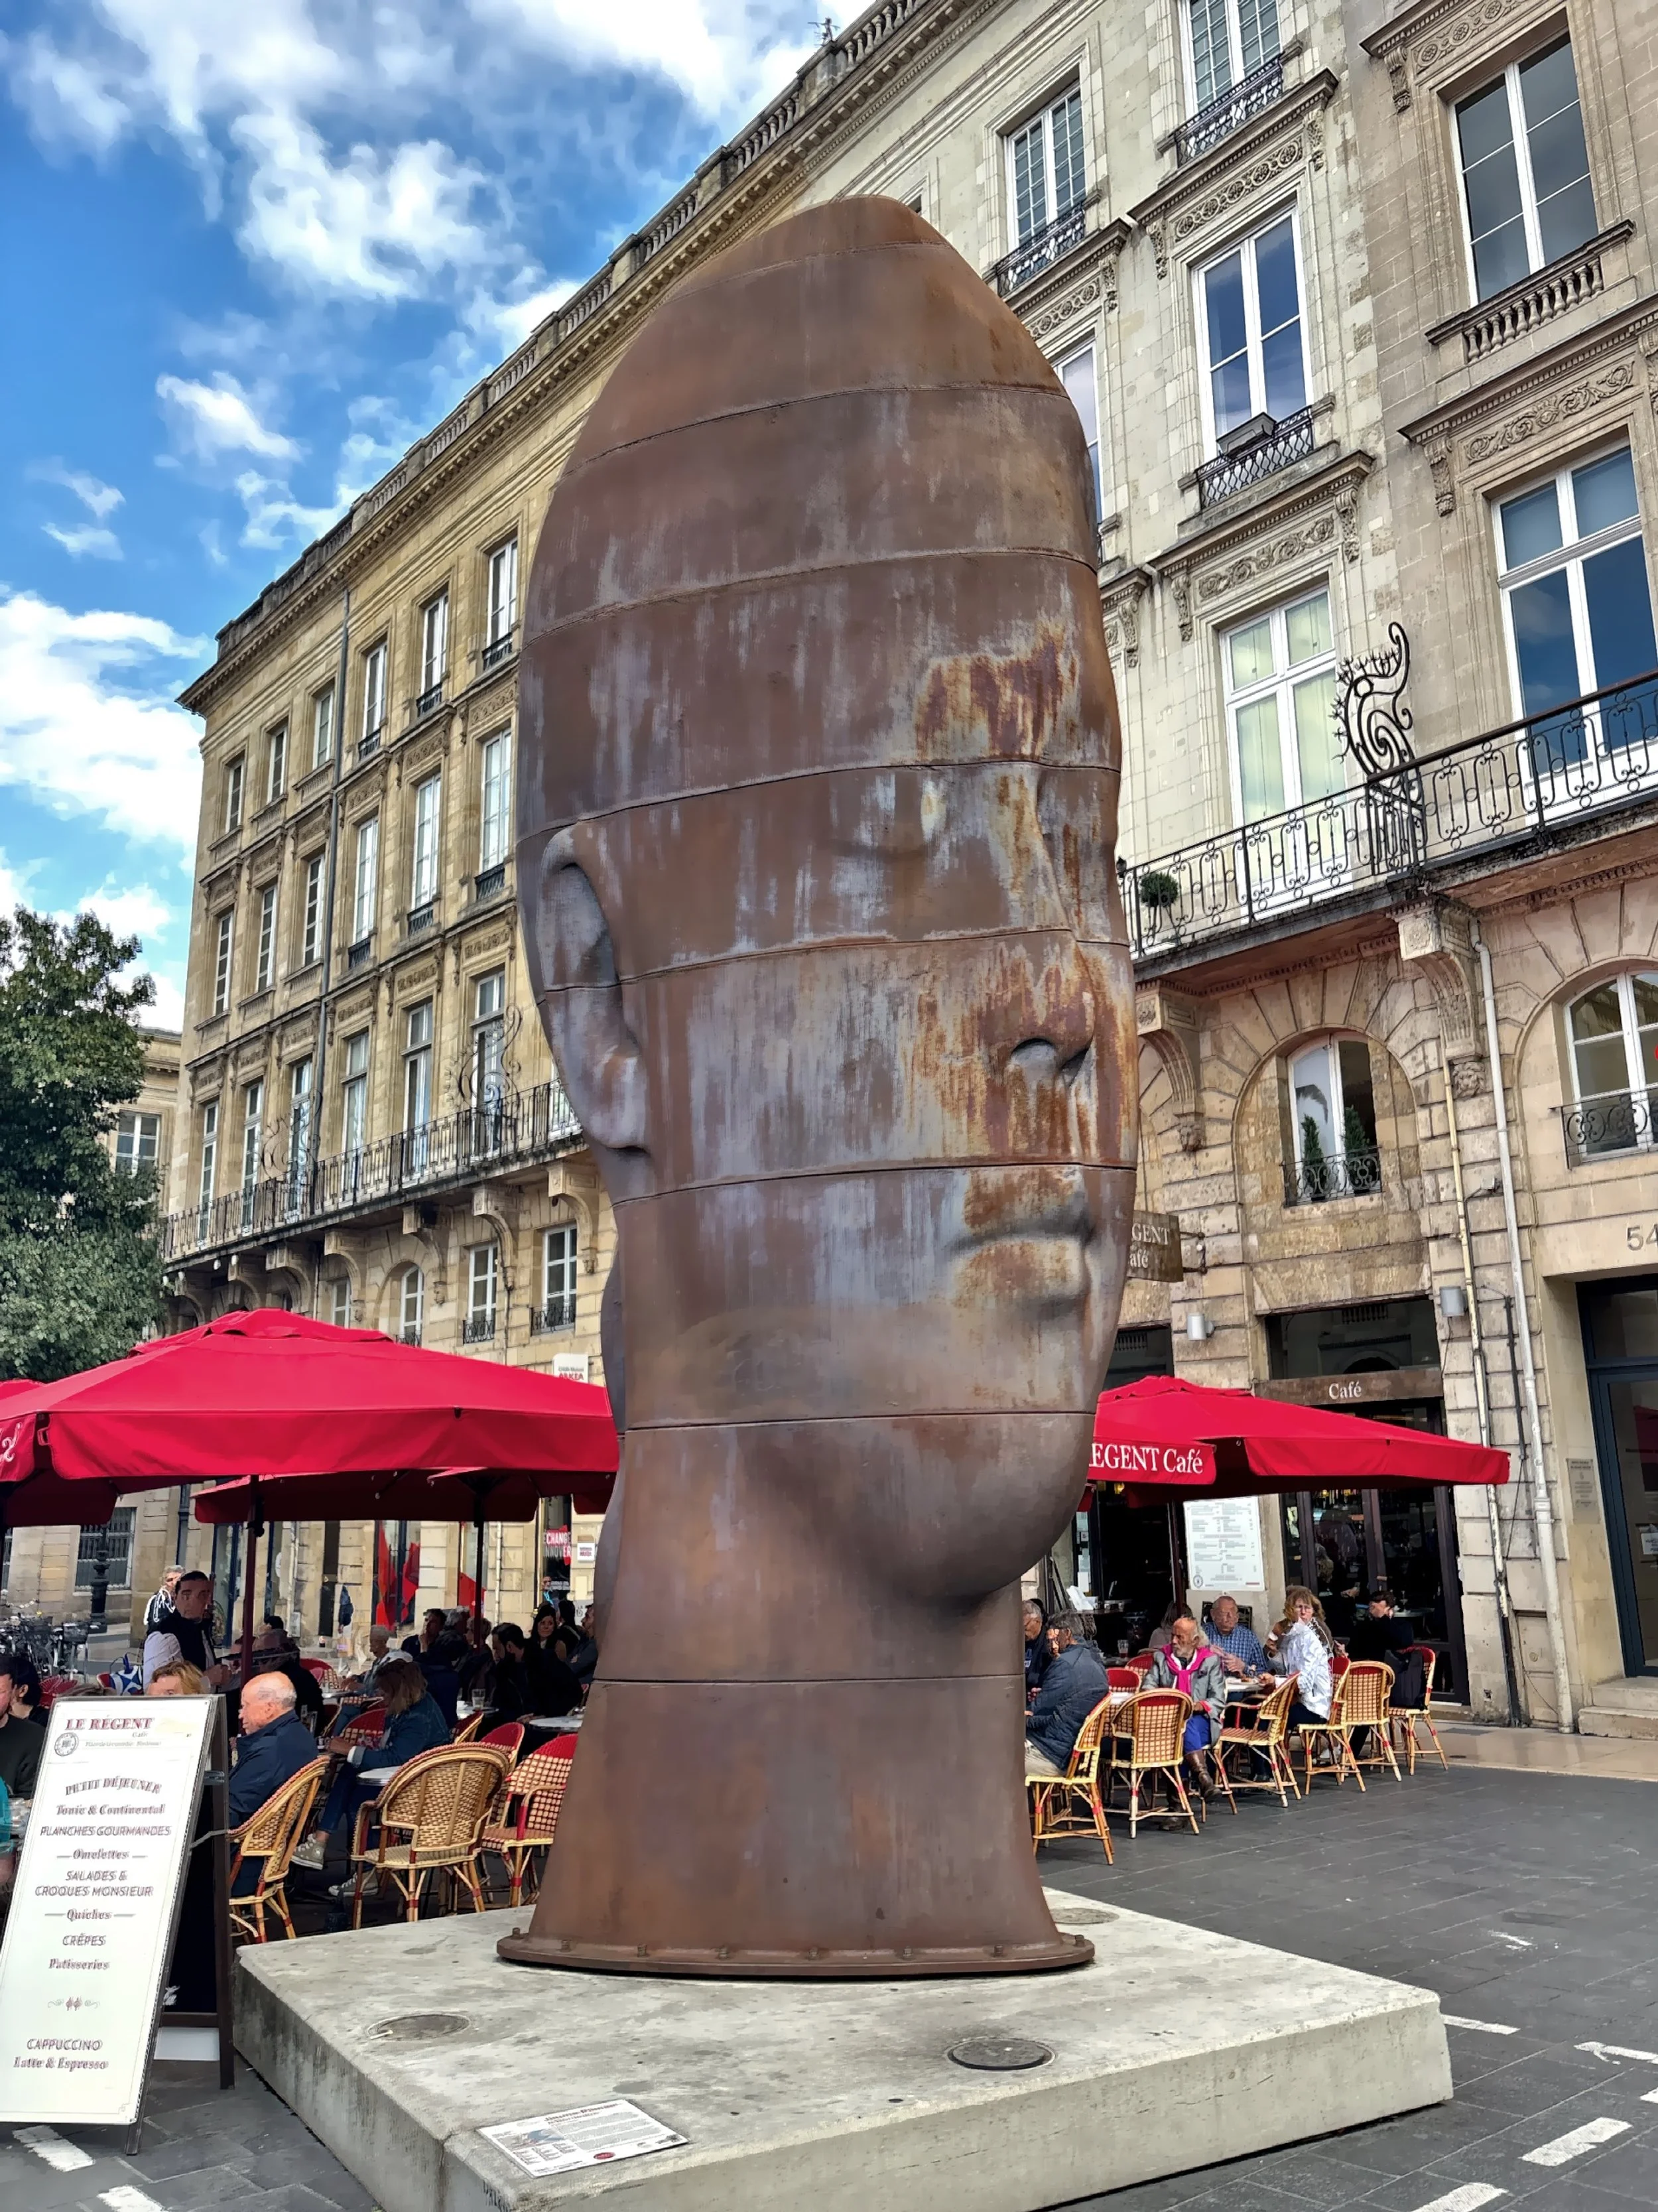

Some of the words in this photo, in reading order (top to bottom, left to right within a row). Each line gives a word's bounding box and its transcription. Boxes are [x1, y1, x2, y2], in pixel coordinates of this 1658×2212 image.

[1627, 1224, 1658, 1251] 54
[1129, 1248, 1149, 1268] afé
[1329, 1380, 1362, 1399] Café
[1089, 1443, 1159, 1471] EGENT
[1163, 1449, 1203, 1474] Café
[65, 1719, 86, 1730] LE
[89, 1715, 153, 1730] RÉGENT
[88, 1805, 97, 1815] &
[99, 1803, 166, 1815] Continental
[40, 1826, 95, 1836] PLANCHES
[96, 1826, 172, 1836] GOURMANDES
[73, 1849, 129, 1860] Omelettes
[66, 1870, 115, 1881] SALADES
[35, 1886, 90, 1897] CROQUES
[92, 1886, 154, 1897] MONSIEUR
[66, 1909, 112, 1921] Quiches
[62, 1933, 106, 1946] CRÊPES
[27, 2038, 103, 2051] CAPPUCCINO
[13, 2056, 44, 2068] Latte
[46, 2057, 54, 2068] &
[57, 2057, 109, 2072] Espresso
